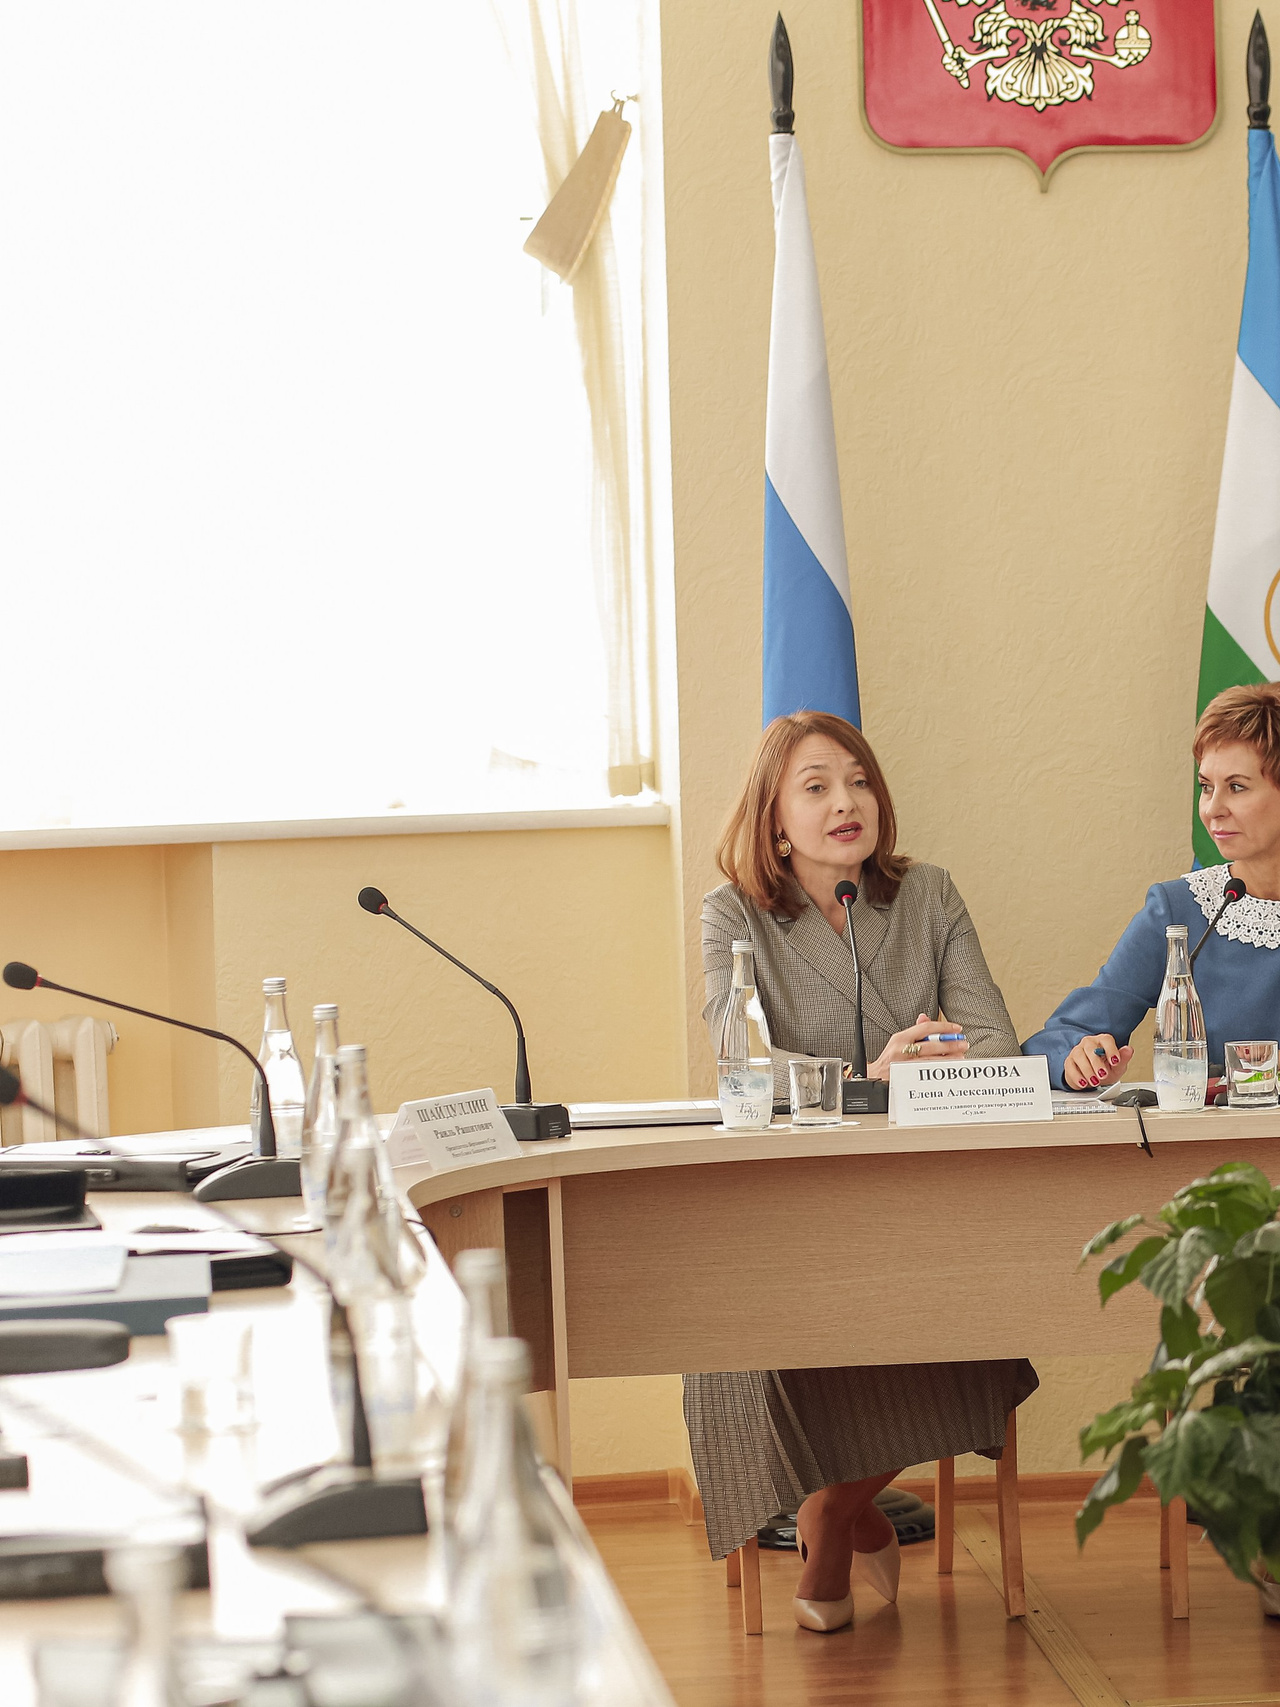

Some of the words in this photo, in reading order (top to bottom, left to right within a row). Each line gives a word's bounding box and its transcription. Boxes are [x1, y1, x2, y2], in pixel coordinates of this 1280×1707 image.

[918, 1065, 1021, 1081] ПОВОРОВА
[909, 1089, 943, 1100] Елена
[947, 1086, 1035, 1099] Александровна
[417, 1098, 489, 1122] ШАЙДУЛЛИН
